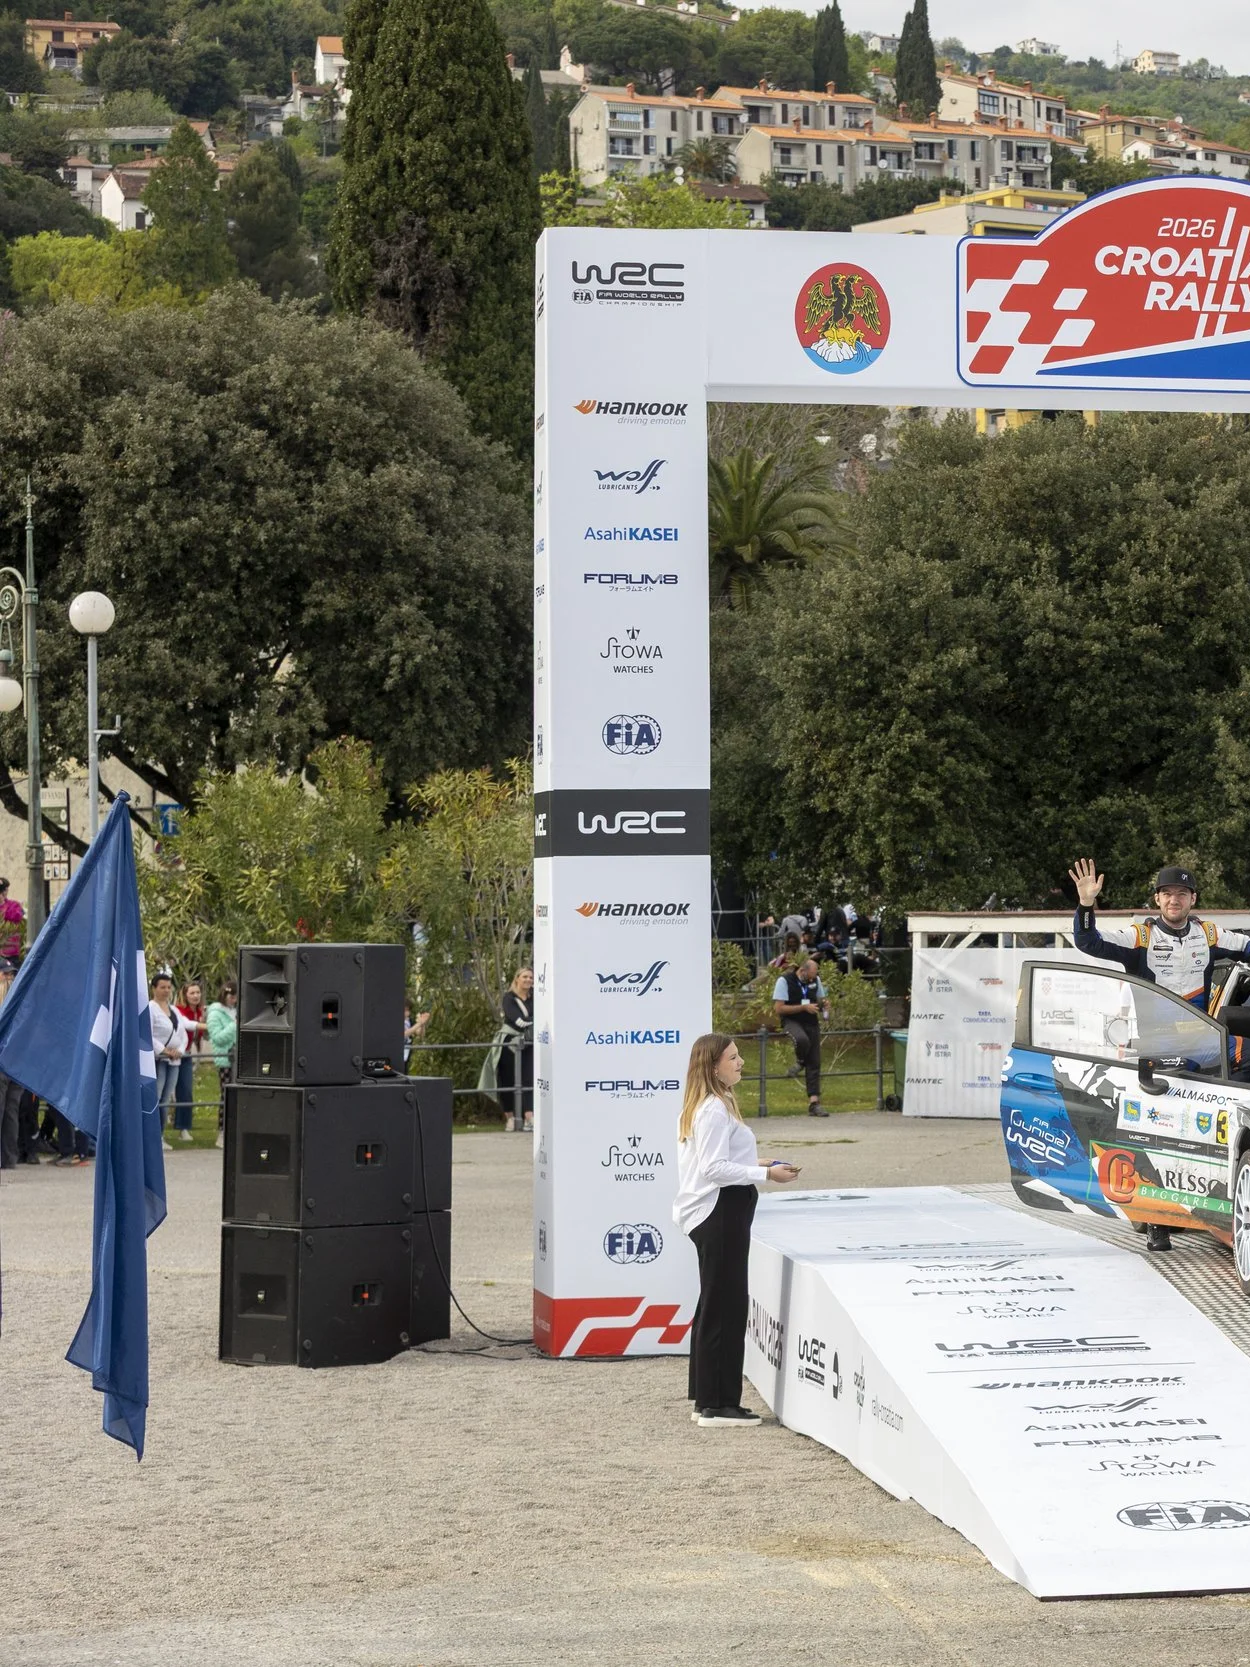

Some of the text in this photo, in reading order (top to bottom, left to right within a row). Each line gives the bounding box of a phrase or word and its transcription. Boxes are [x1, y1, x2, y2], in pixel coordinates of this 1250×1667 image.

[1157, 217, 1217, 238] 2026
[571, 260, 685, 287] WRC
[617, 416, 687, 427] driving emotion
[597, 483, 638, 491] LUBRICANTS
[584, 573, 678, 585] FORUM8
[613, 665, 654, 674] WATCHES
[577, 810, 686, 835] WRC
[619, 916, 689, 927] driving emotion
[585, 1079, 680, 1092] FORUM8
[906, 1077, 944, 1085] FANATEC
[1174, 1087, 1239, 1106] ALMASPO
[1033, 1116, 1049, 1129] FIA
[1013, 1119, 1065, 1148] JUNIOR
[1006, 1126, 1066, 1166] WRC
[614, 1173, 655, 1182] WATCHES
[1141, 1186, 1209, 1208] BYGGARE
[934, 1335, 1146, 1351] WRC
[798, 1334, 826, 1370] WRC
[1033, 1434, 1223, 1448] FORUM8
[1120, 1469, 1204, 1477] WATCHES
